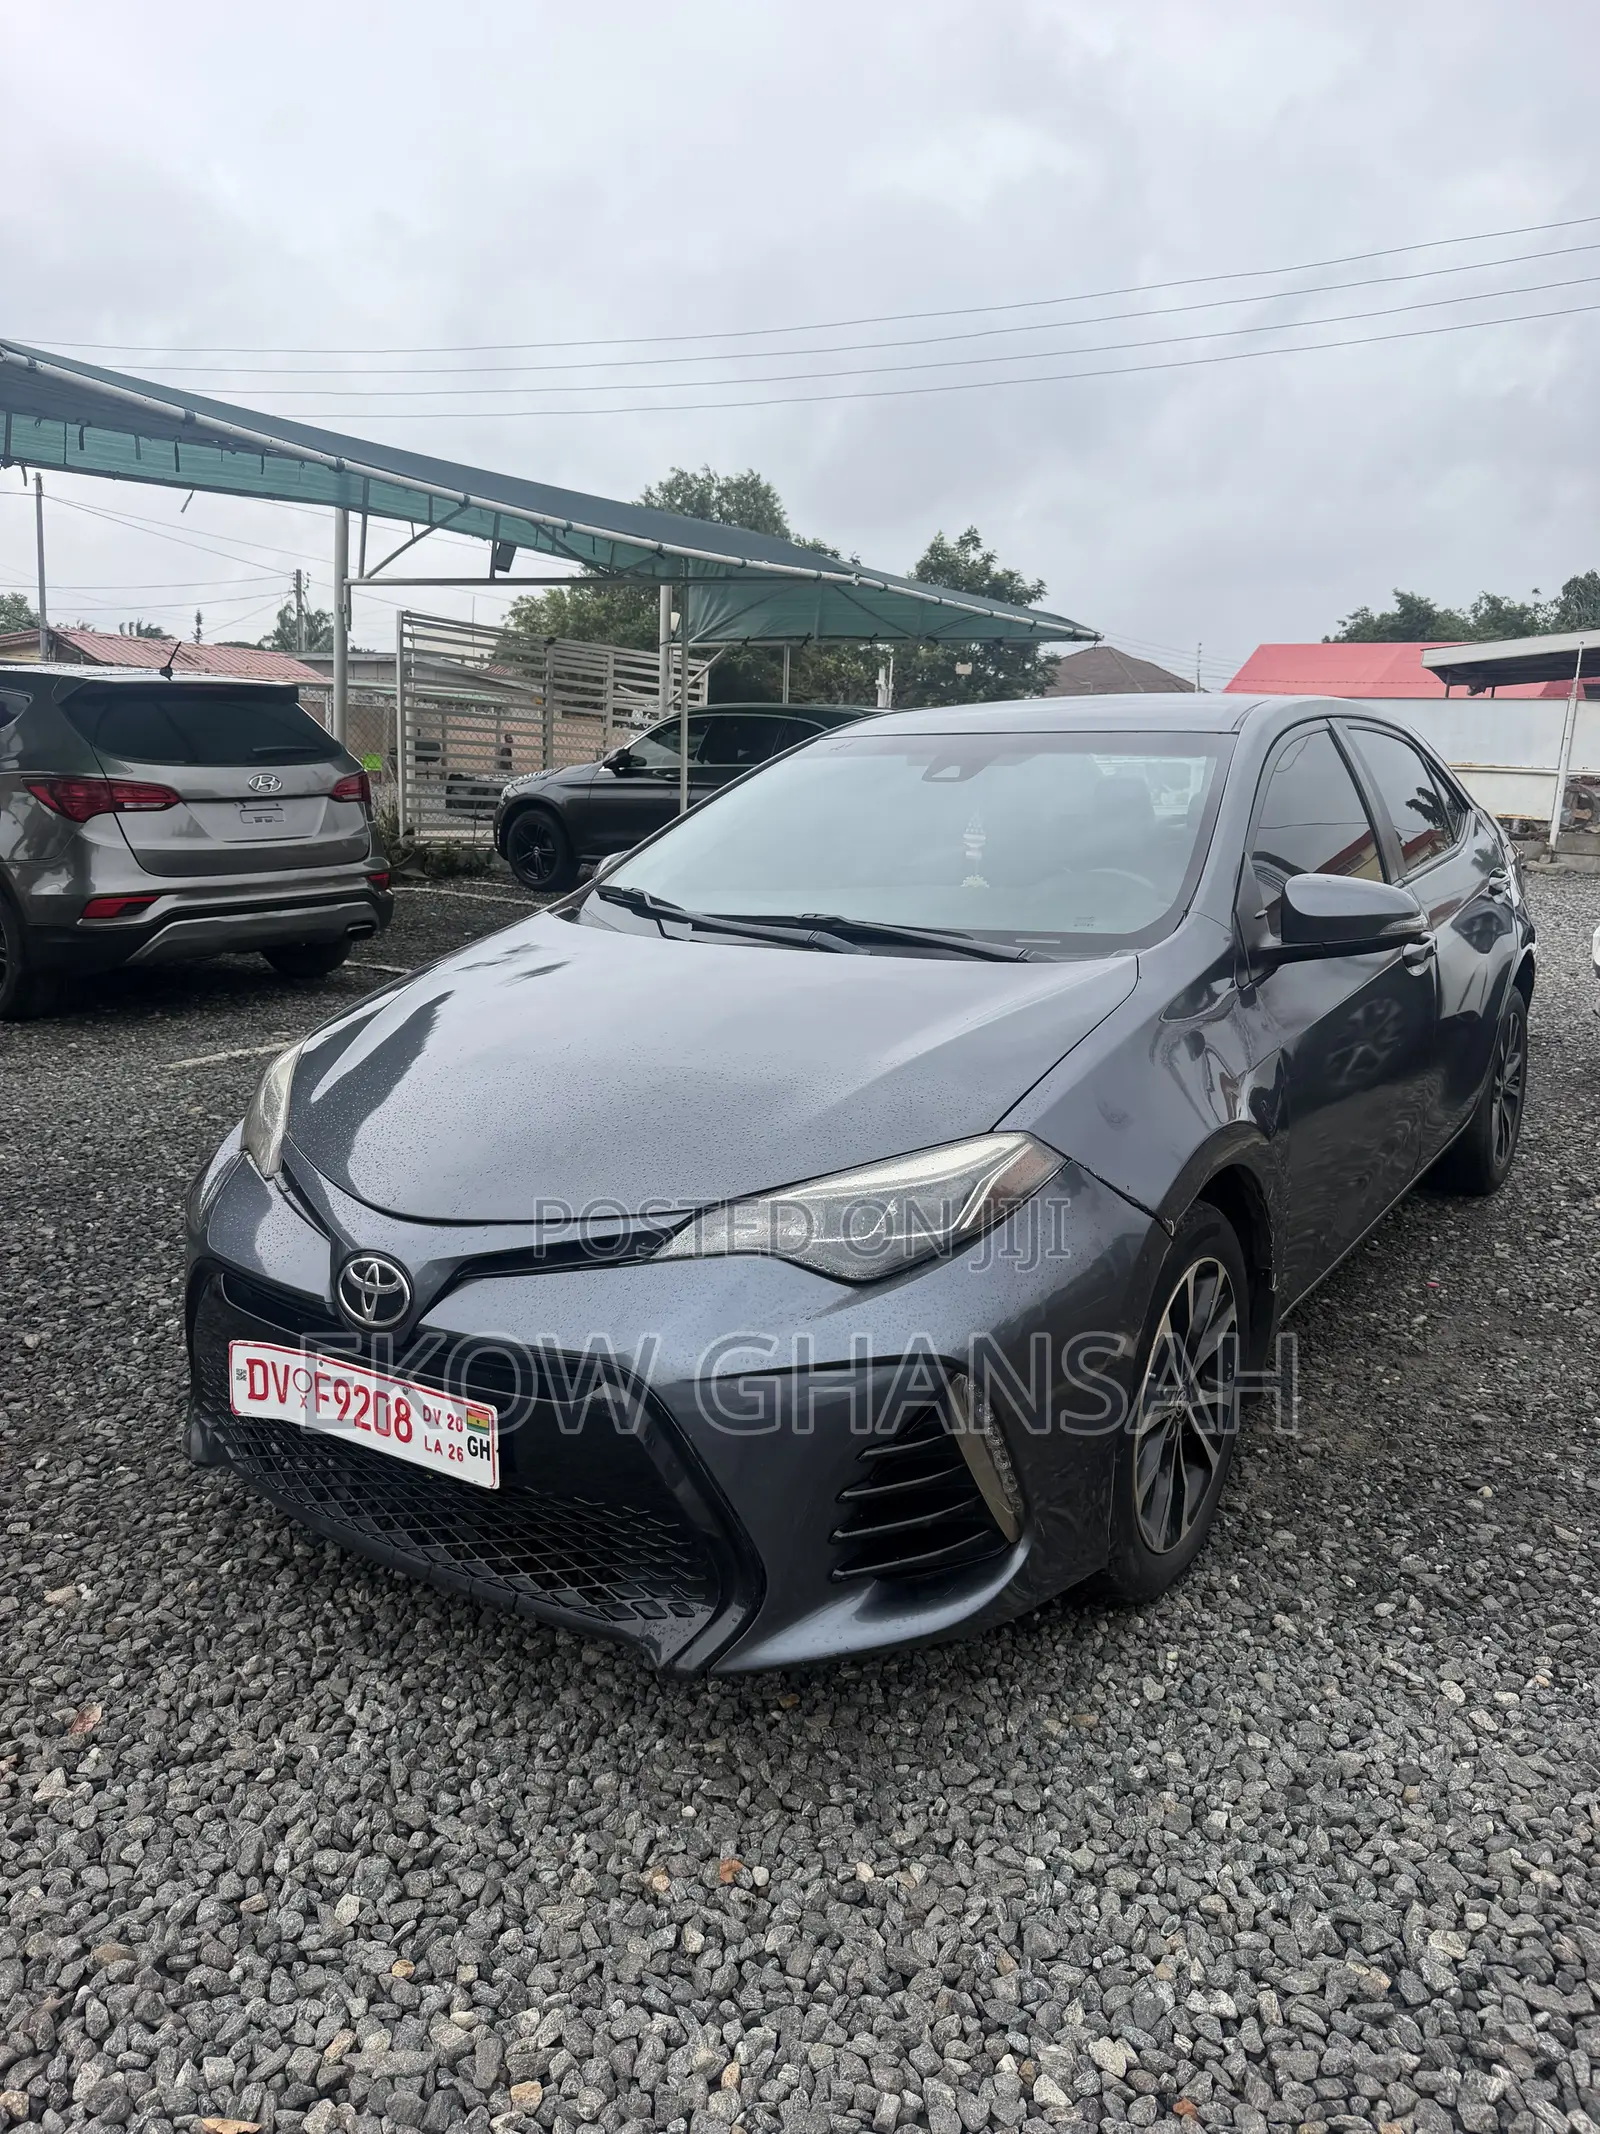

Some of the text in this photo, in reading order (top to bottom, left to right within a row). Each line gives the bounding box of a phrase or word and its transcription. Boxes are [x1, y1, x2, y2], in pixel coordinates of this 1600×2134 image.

[246, 1358, 290, 1404] DV
[314, 1371, 413, 1443] F9208
[422, 1404, 463, 1433] DV 20
[424, 1435, 464, 1462] LA 26
[467, 1435, 491, 1462] GH
